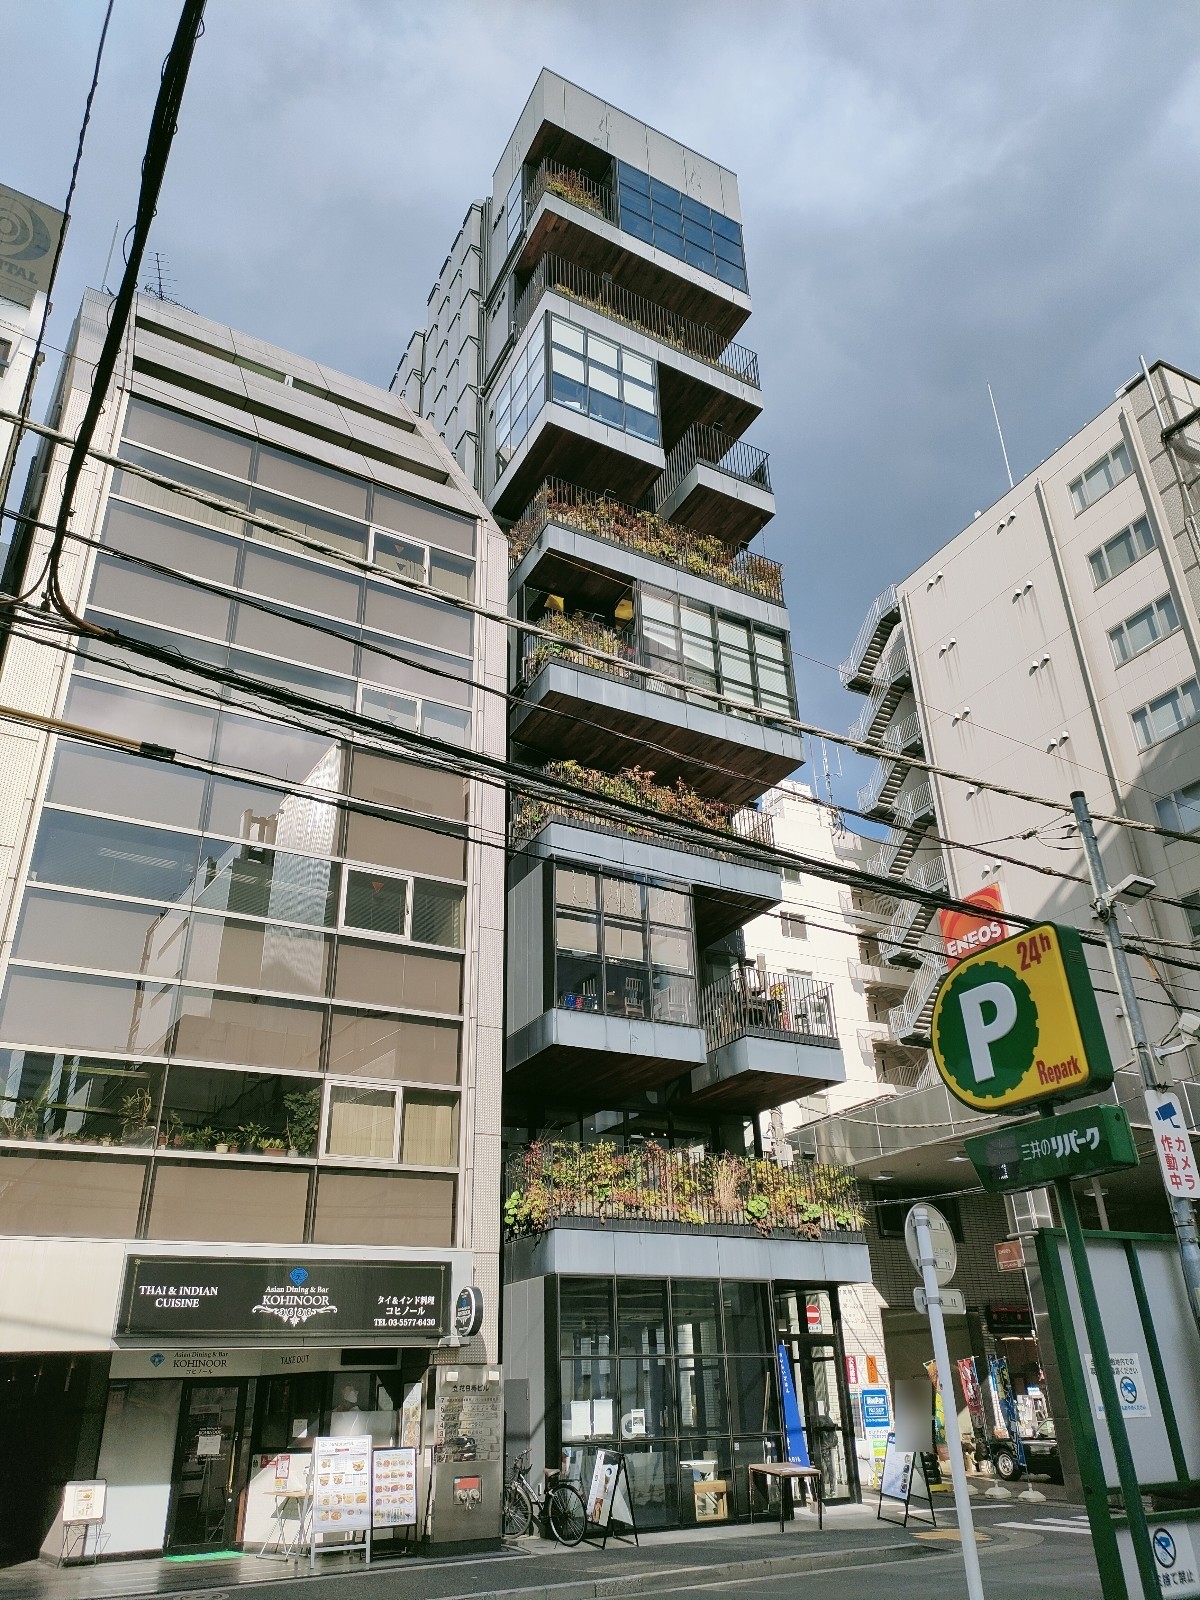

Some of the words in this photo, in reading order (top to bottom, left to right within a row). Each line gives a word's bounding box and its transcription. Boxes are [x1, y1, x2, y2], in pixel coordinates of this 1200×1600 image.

[947, 922, 1002, 957] ENEOS
[1016, 932, 1052, 972] 24h
[958, 981, 1018, 1084] P
[1036, 1055, 1082, 1086] Repark
[1020, 1127, 1100, 1161] 三井のリパーク
[1160, 1134, 1183, 1190] 作動中
[1175, 1136, 1196, 1190] カメラ
[139, 1285, 167, 1295] THAI
[169, 1286, 178, 1295] &
[179, 1286, 219, 1296] INDIAN
[262, 1295, 330, 1306] KOHINOOR
[286, 1285, 310, 1295] Dining
[155, 1298, 200, 1308] CUISINE
[385, 1306, 426, 1316] コヒノール
[374, 1318, 387, 1326] TEL
[173, 1359, 228, 1368] KOHINOOR
